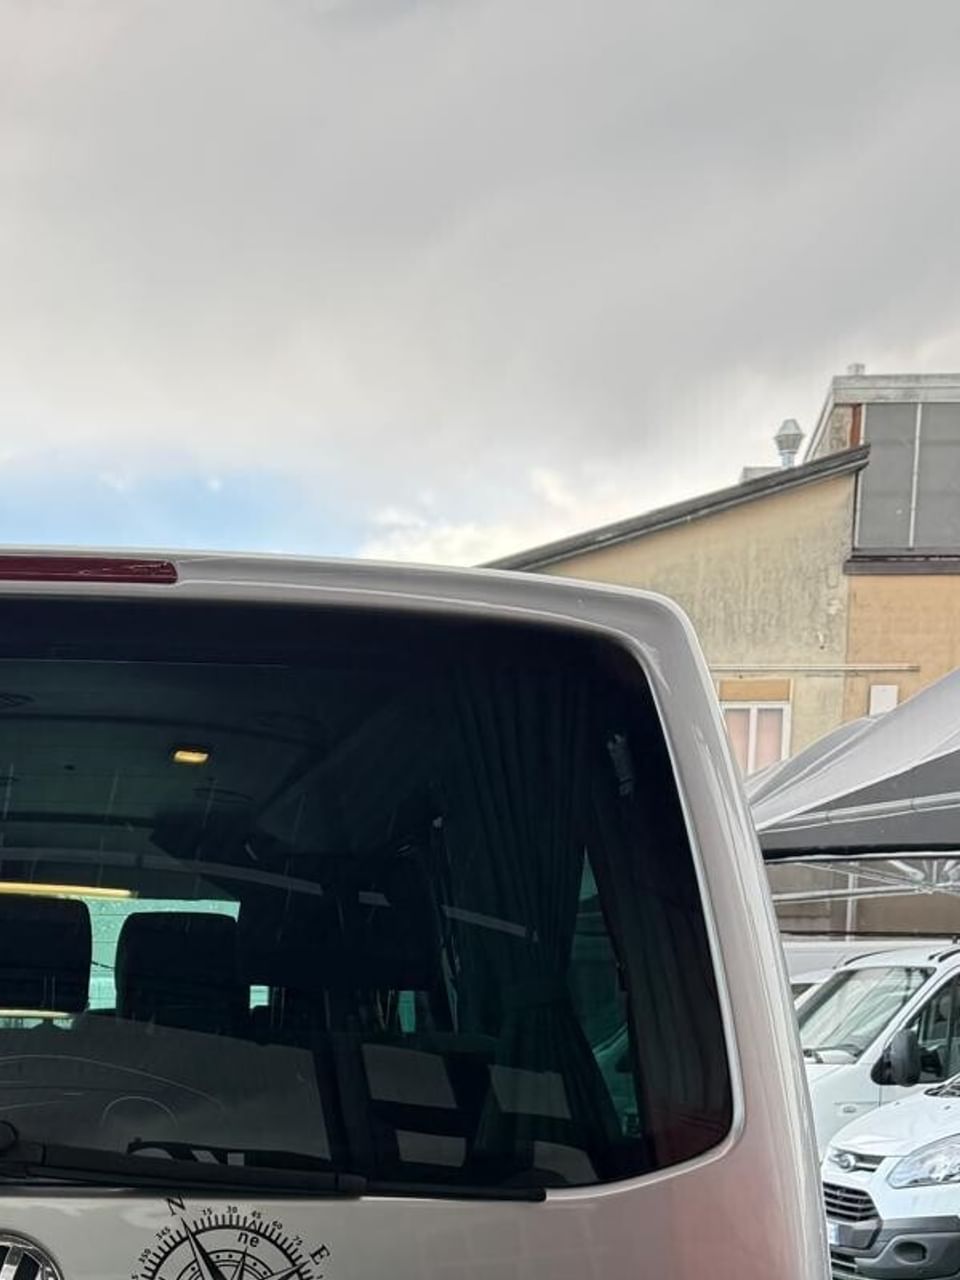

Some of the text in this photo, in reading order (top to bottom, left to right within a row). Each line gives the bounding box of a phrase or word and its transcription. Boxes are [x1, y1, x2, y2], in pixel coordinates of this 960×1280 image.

[165, 1193, 186, 1216] N
[226, 1205, 238, 1214] 30
[202, 1207, 213, 1216] 15
[251, 1210, 262, 1220] 45
[271, 1220, 283, 1230] 60
[237, 1231, 261, 1248] ne
[309, 1243, 331, 1266] E
